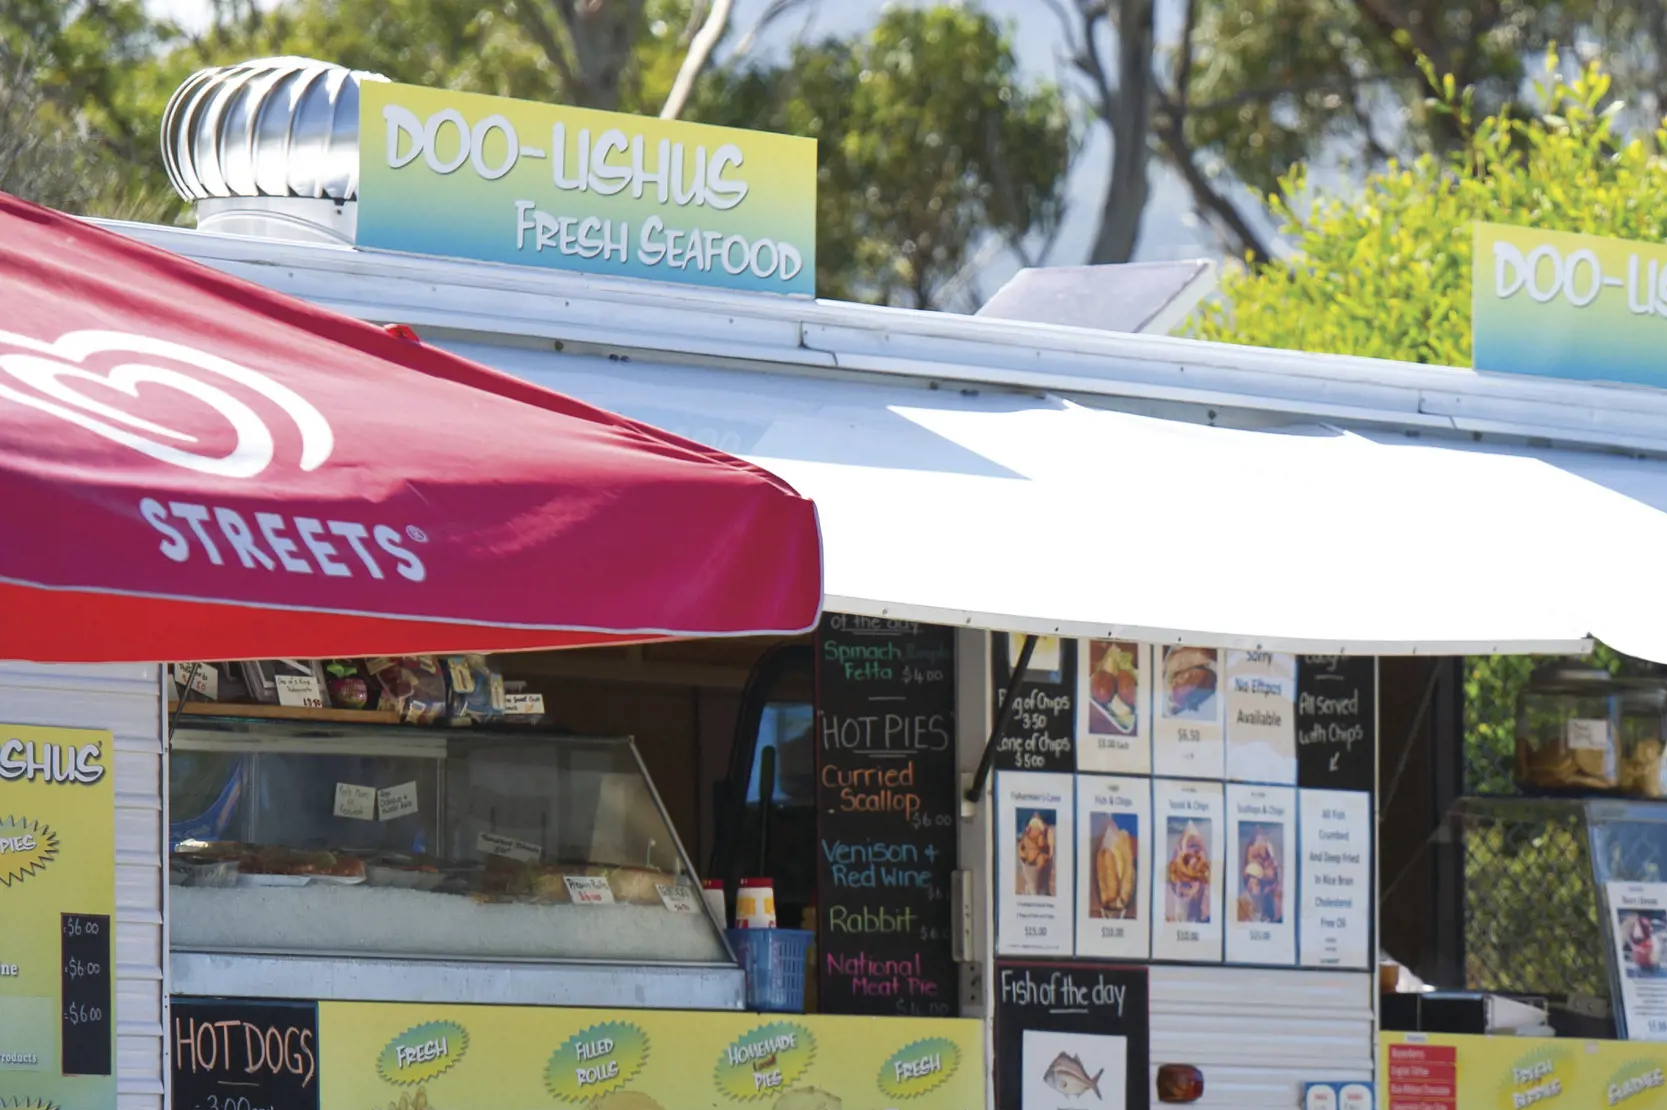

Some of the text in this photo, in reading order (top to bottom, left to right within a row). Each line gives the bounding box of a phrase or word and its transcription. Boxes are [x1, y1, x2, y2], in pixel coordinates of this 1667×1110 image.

[514, 200, 804, 281] FRESH SEAFOOD
[139, 497, 427, 582] STREETS
[824, 640, 900, 664] Spinach
[844, 661, 893, 681] Fetta
[1235, 677, 1249, 691] No
[1300, 692, 1316, 716] All
[1237, 709, 1282, 726] Available
[1038, 732, 1071, 757] Chips
[1328, 723, 1363, 752] Chips
[822, 761, 913, 787] Curried
[840, 789, 920, 821] Scallop
[822, 838, 918, 863] Venison
[833, 864, 932, 888] Red Wine
[829, 905, 917, 932] Rabbit
[827, 952, 921, 976] National
[852, 977, 900, 996] Meat
[1001, 970, 1126, 1017] Fish of the day
[0, 1052, 38, 1064] roducts
[176, 1017, 315, 1089] HOT DOGS
[396, 1036, 449, 1069] FRESH
[575, 1038, 614, 1062] FILLED
[727, 1032, 798, 1067] HOMEMADE
[576, 1060, 619, 1087] ROLLS
[753, 1069, 783, 1092] PIES
[893, 1053, 941, 1083] FRESH
